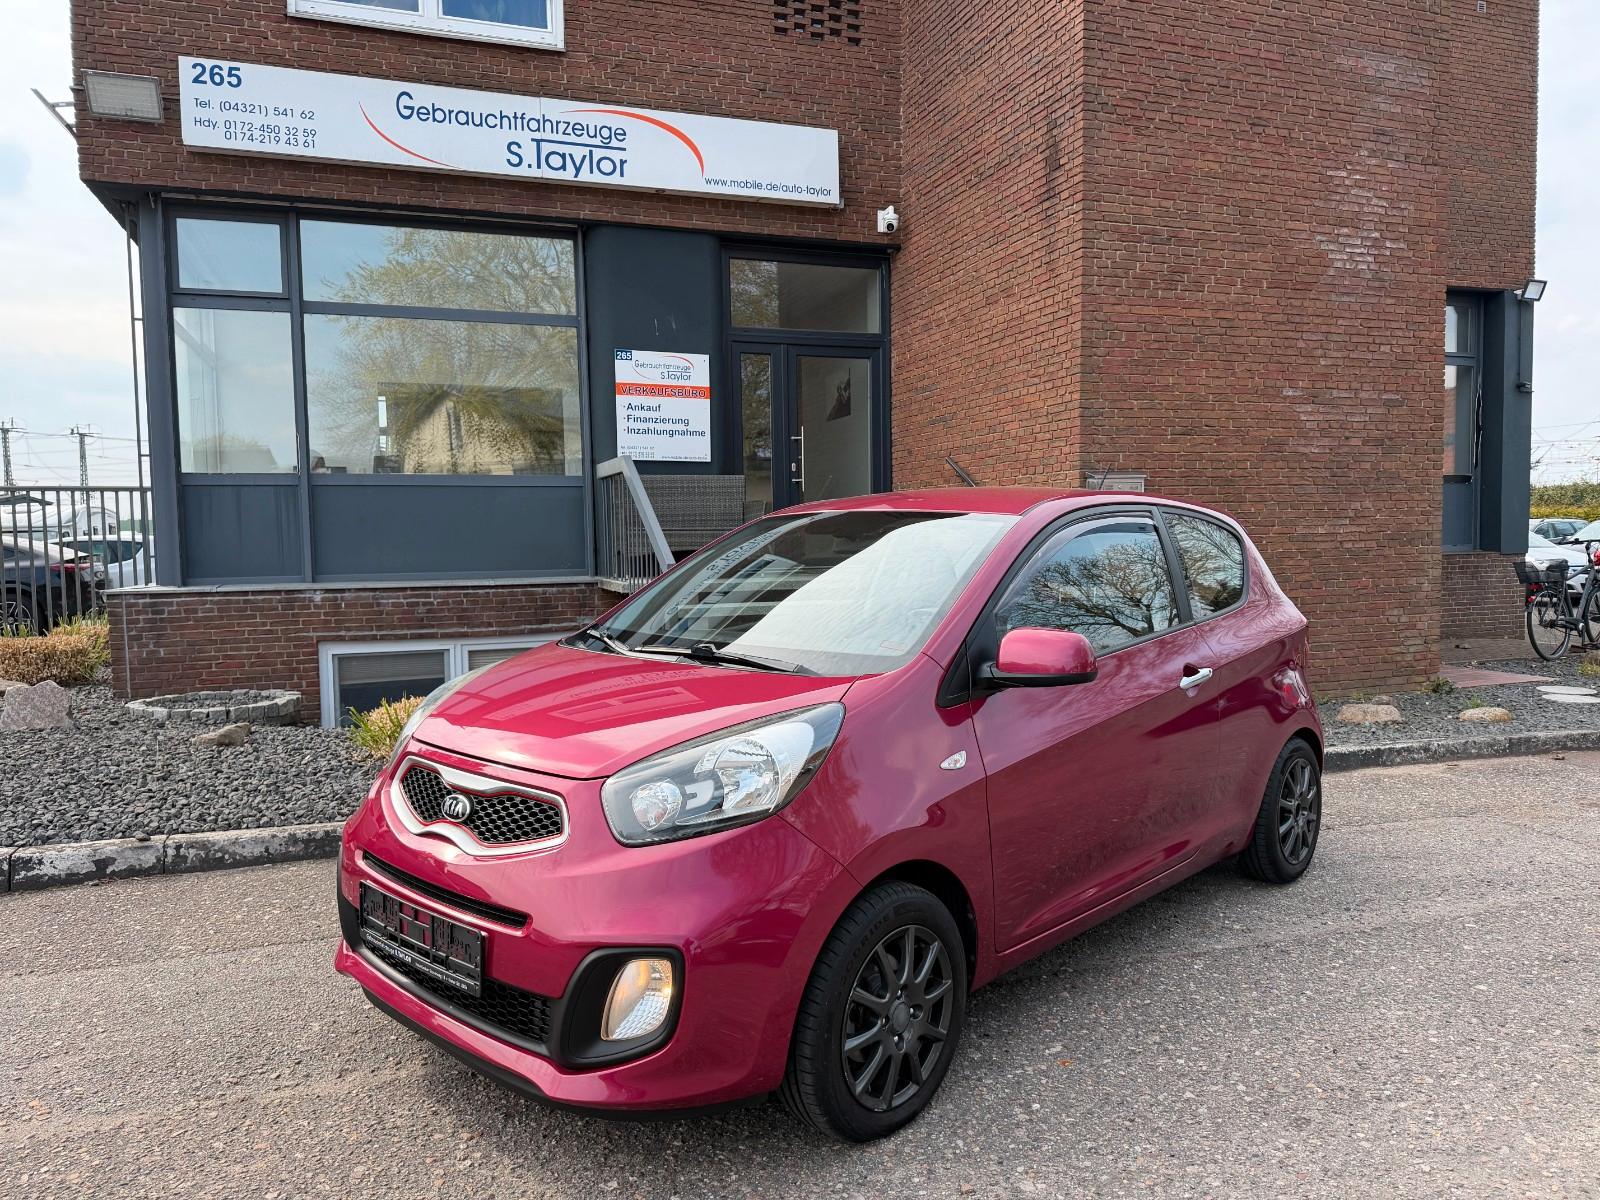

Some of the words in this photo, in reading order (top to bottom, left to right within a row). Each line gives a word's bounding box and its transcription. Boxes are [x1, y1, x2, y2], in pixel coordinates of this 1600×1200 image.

[191, 62, 243, 88] 265
[193, 98, 215, 110] Tel.
[219, 100, 268, 117] (04321)
[273, 106, 294, 118] 541
[299, 109, 315, 121] 62
[395, 90, 627, 145] Gebrauchtfahrzeuge
[193, 116, 220, 130] Hdy.
[223, 119, 281, 135] 0172-450
[284, 126, 299, 137] 32
[302, 128, 317, 139] 59
[224, 130, 281, 145] 0174-219
[284, 137, 299, 147] 43
[302, 138, 316, 149] 61
[506, 138, 628, 179] S.Taylor
[704, 176, 832, 198] www.mobile.de/auto-taylor
[616, 351, 632, 360] 265
[660, 370, 692, 382] S.Taylor
[621, 385, 706, 398] VERKAUFSBÜRO
[626, 402, 661, 412] Ankauf
[626, 414, 690, 427] Finanzierung
[627, 426, 706, 438] Inzahlungnahme
[443, 797, 463, 818] KIA
